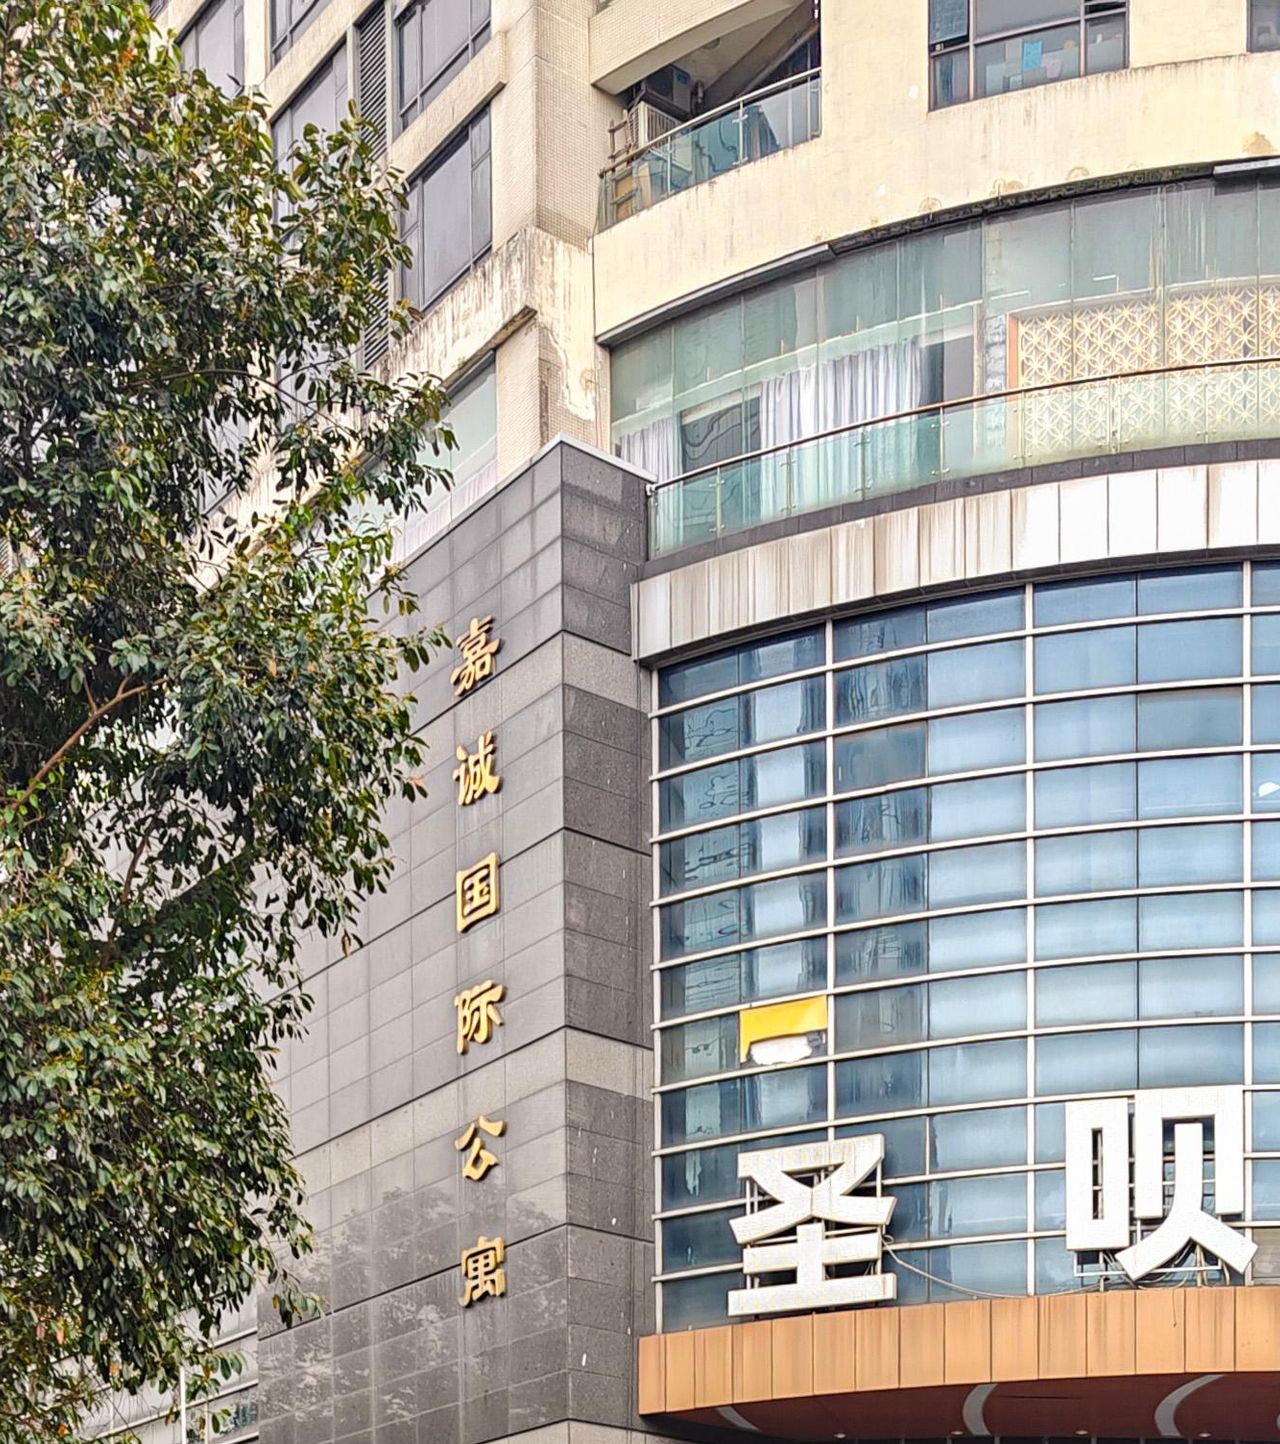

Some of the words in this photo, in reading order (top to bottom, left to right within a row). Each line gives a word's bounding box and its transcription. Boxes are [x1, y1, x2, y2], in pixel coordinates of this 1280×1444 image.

[451, 616, 506, 1307] 嘉诚国际公寓
